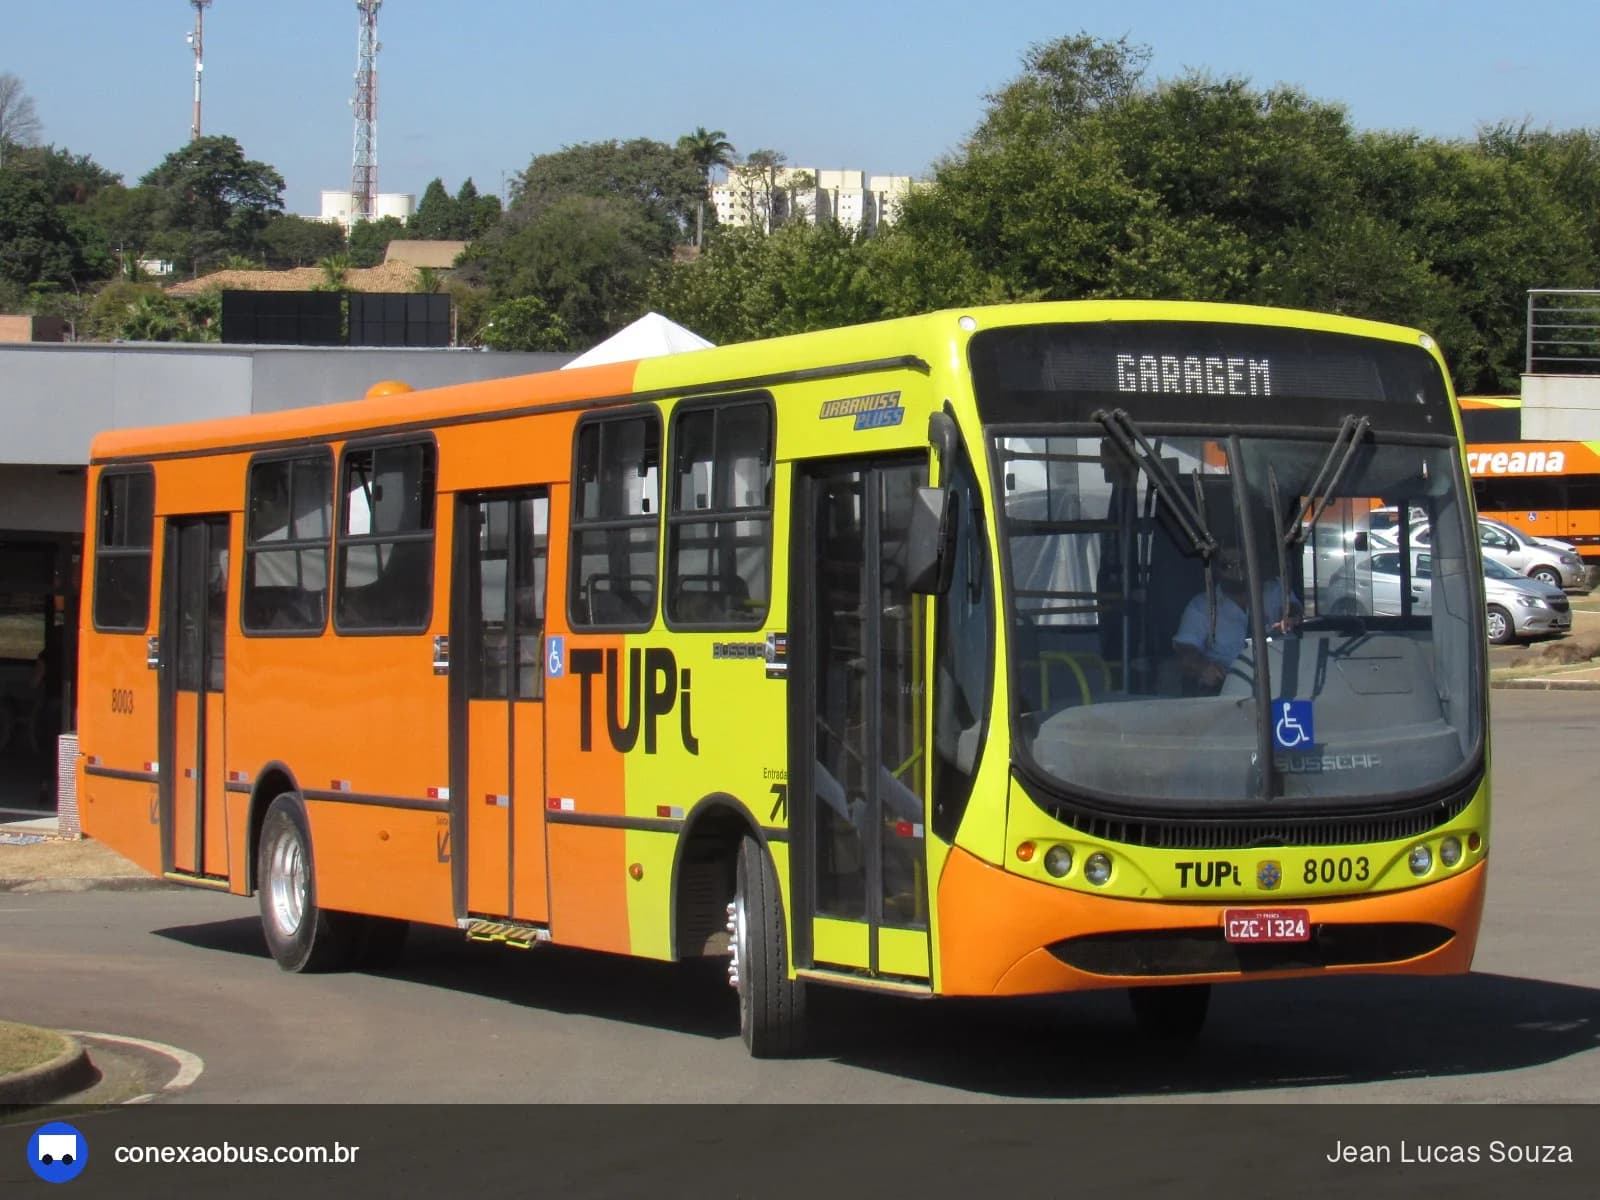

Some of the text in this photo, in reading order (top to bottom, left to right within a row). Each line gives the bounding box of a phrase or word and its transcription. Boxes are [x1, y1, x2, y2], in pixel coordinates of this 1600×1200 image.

[1117, 354, 1271, 396] GARAGEM
[820, 391, 901, 419] URBANUSS
[854, 408, 905, 430] PLUSS
[111, 689, 134, 714] 8003
[1303, 856, 1369, 884] 8003
